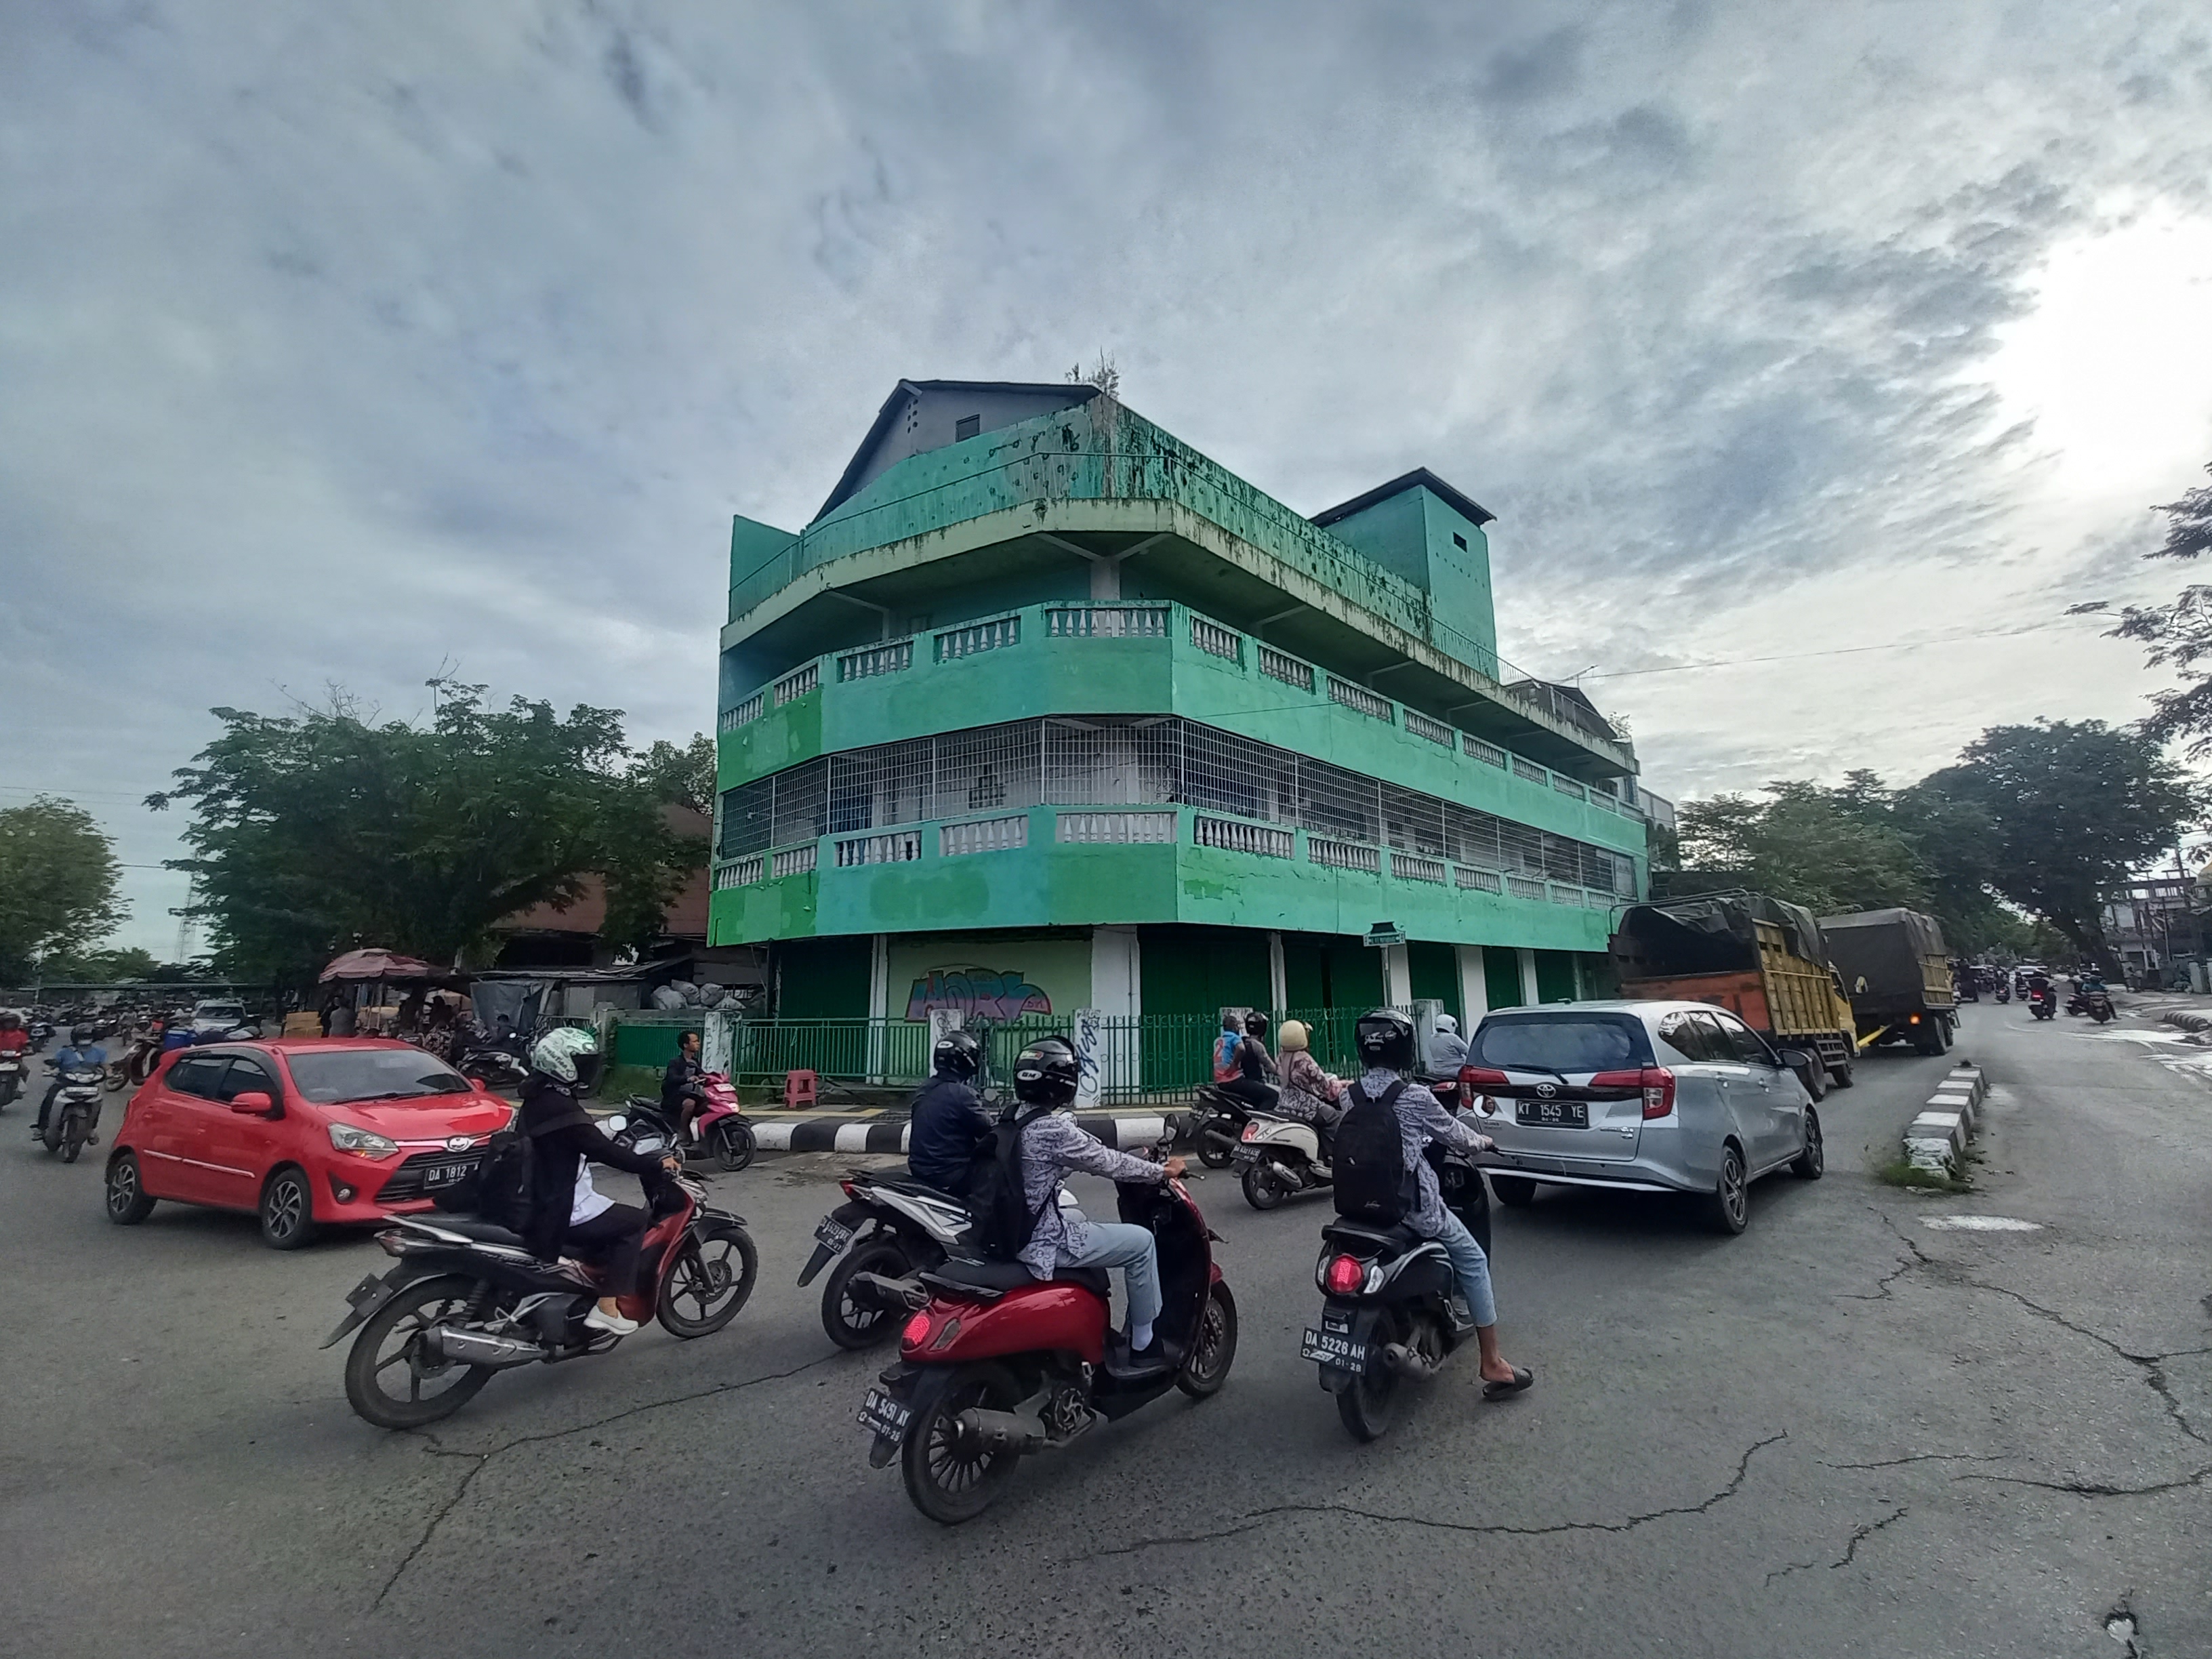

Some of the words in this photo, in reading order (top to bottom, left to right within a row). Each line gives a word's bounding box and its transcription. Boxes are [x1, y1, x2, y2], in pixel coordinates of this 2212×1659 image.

[1517, 1103, 1531, 1115] KT
[1540, 1104, 1562, 1117] 1545
[1572, 1105, 1584, 1118] YE
[428, 1168, 441, 1181] DA
[445, 1165, 468, 1179] 1812
[1305, 1330, 1317, 1347] DA
[1349, 1343, 1366, 1361] AH
[865, 1391, 879, 1410] DA
[896, 1409, 911, 1427] AY
